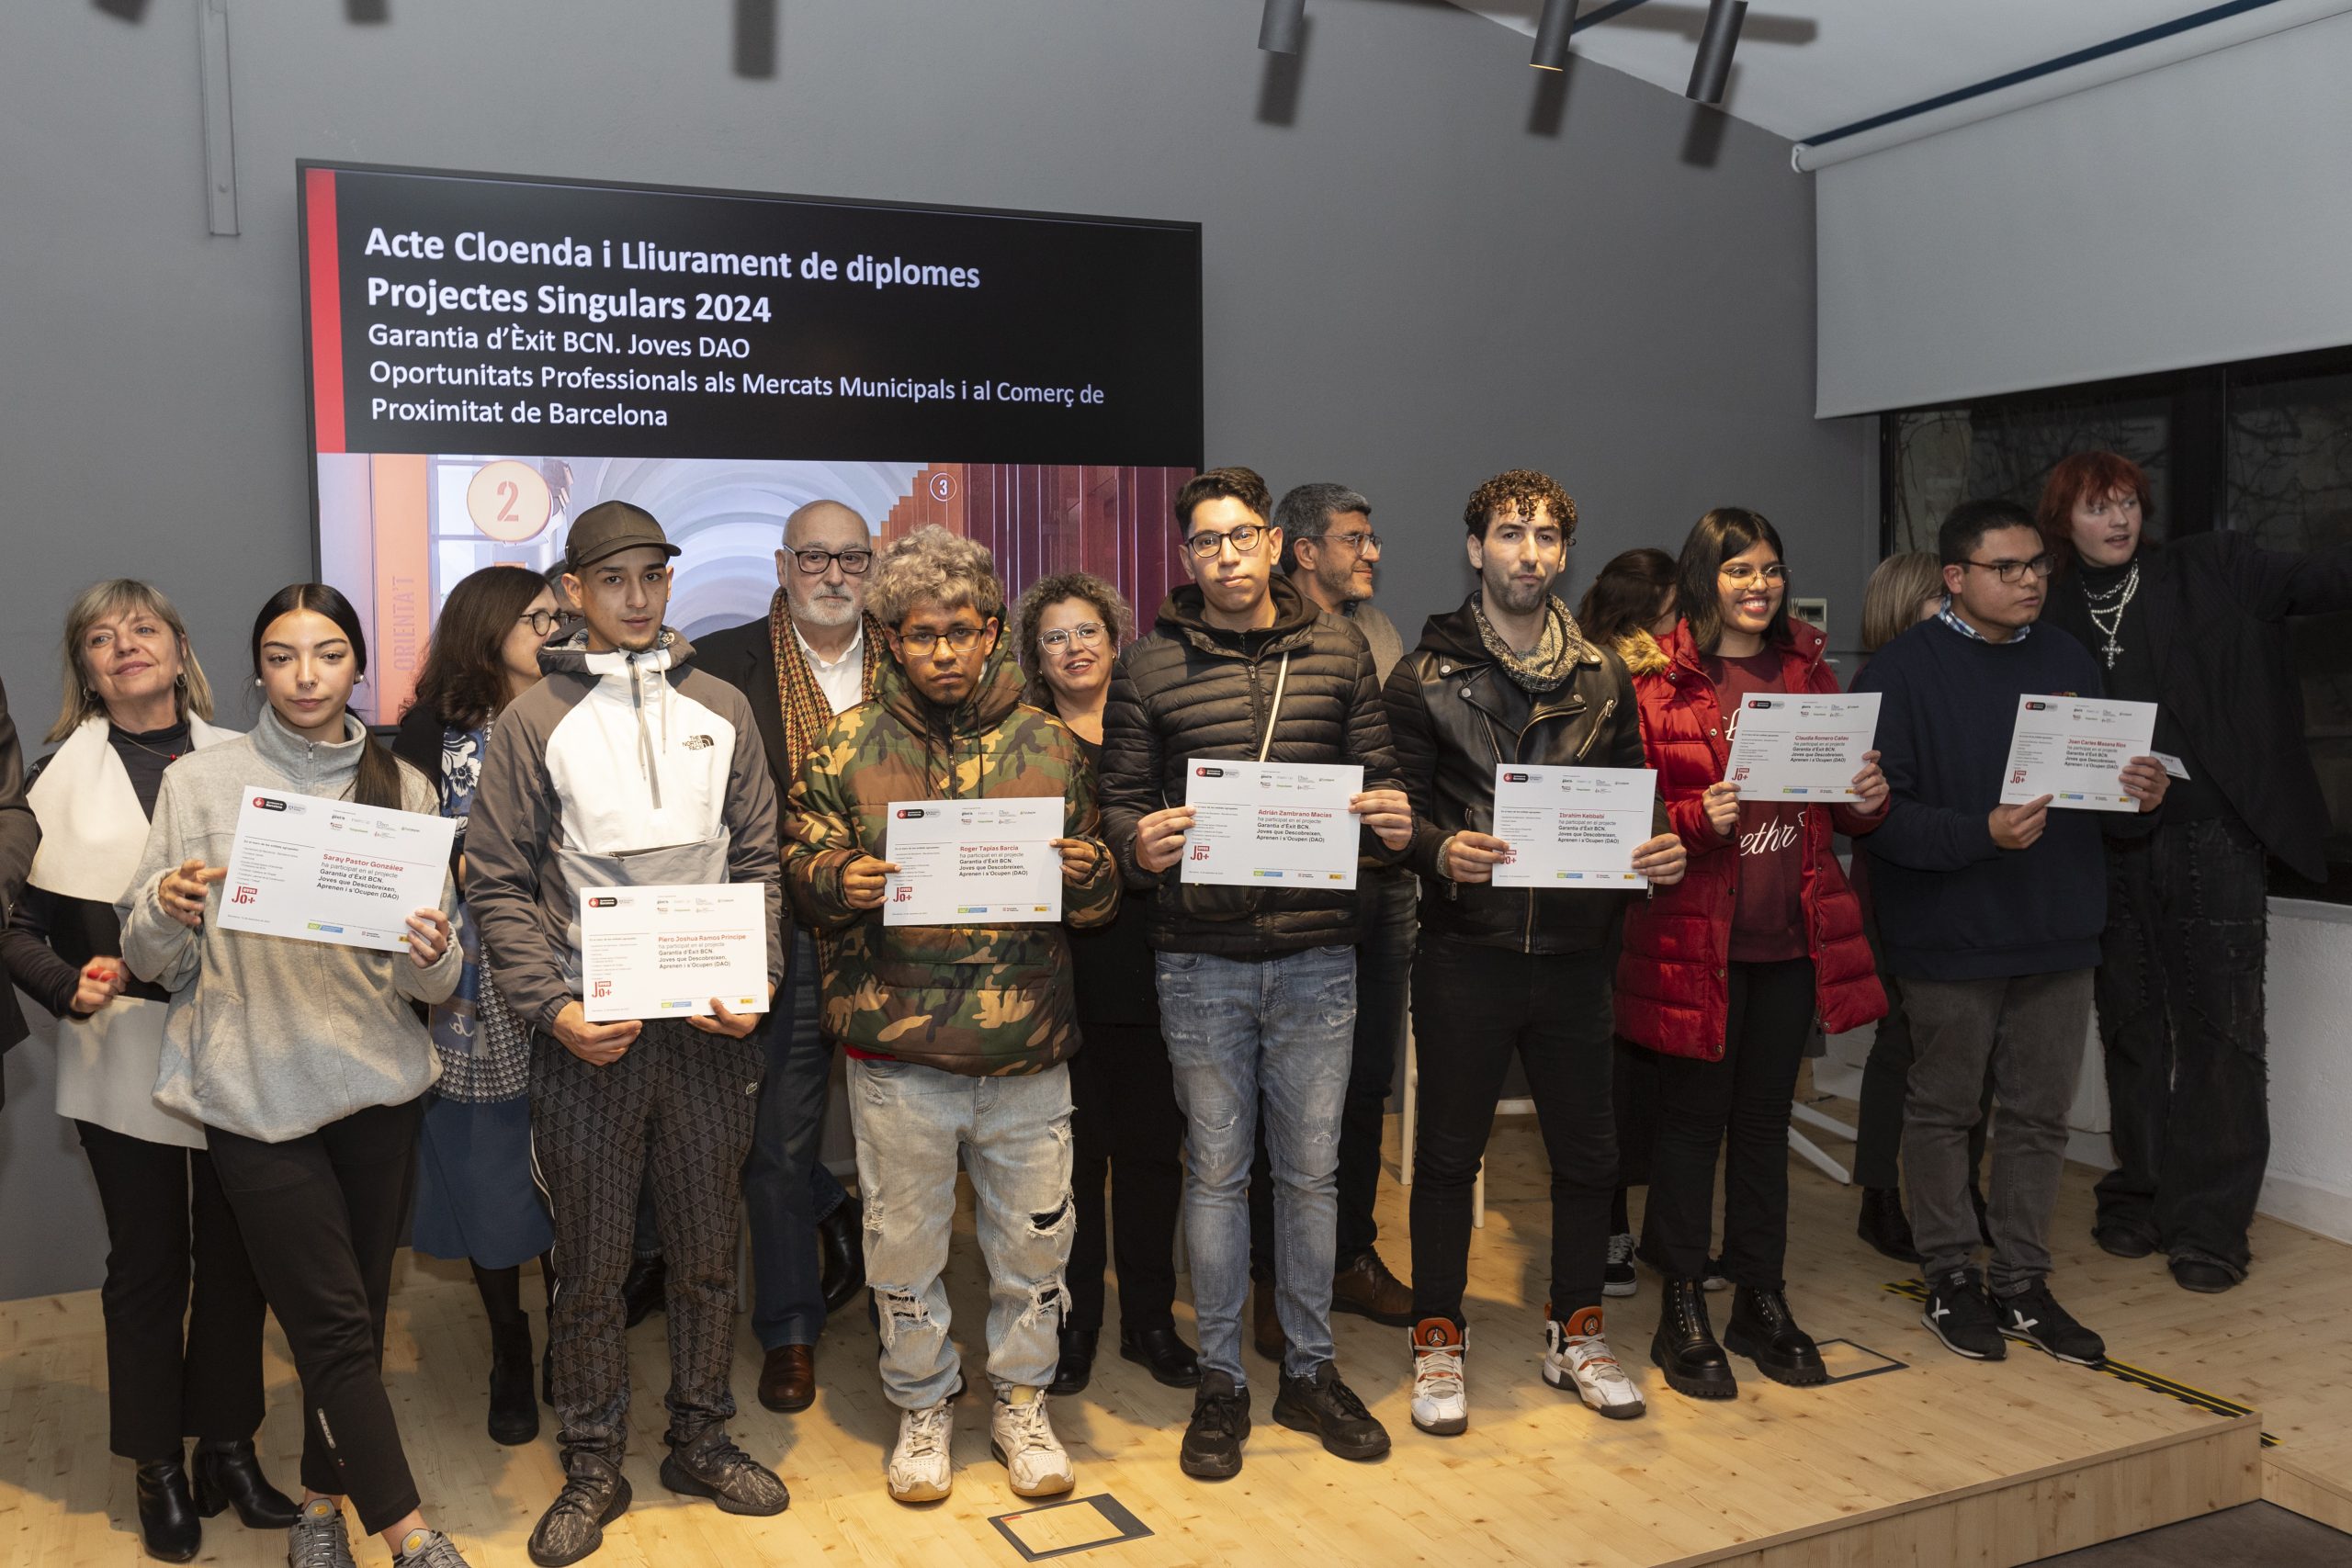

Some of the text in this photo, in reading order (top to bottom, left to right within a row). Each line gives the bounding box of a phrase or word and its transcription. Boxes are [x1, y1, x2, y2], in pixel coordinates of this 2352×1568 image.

[364, 227, 980, 290] Acte Cloenda i Lliurament de diplomes
[368, 276, 773, 323] Projectes Singulars 2024
[368, 322, 751, 359] Garantia d'Èxit BCN. Joves DAO
[369, 359, 1104, 408] Oportunitats Professionals als Mercats Municipals i al Comerç de
[371, 397, 668, 427] Proximitat de Barcelona
[497, 480, 519, 522] 2
[939, 479, 948, 496] 3
[320, 870, 347, 878] Garantia
[323, 854, 345, 863] Saray
[345, 858, 369, 866] Pastor
[316, 884, 344, 892] Aprenen
[379, 892, 400, 900] (DAO)
[352, 881, 395, 892] Descobreixen,
